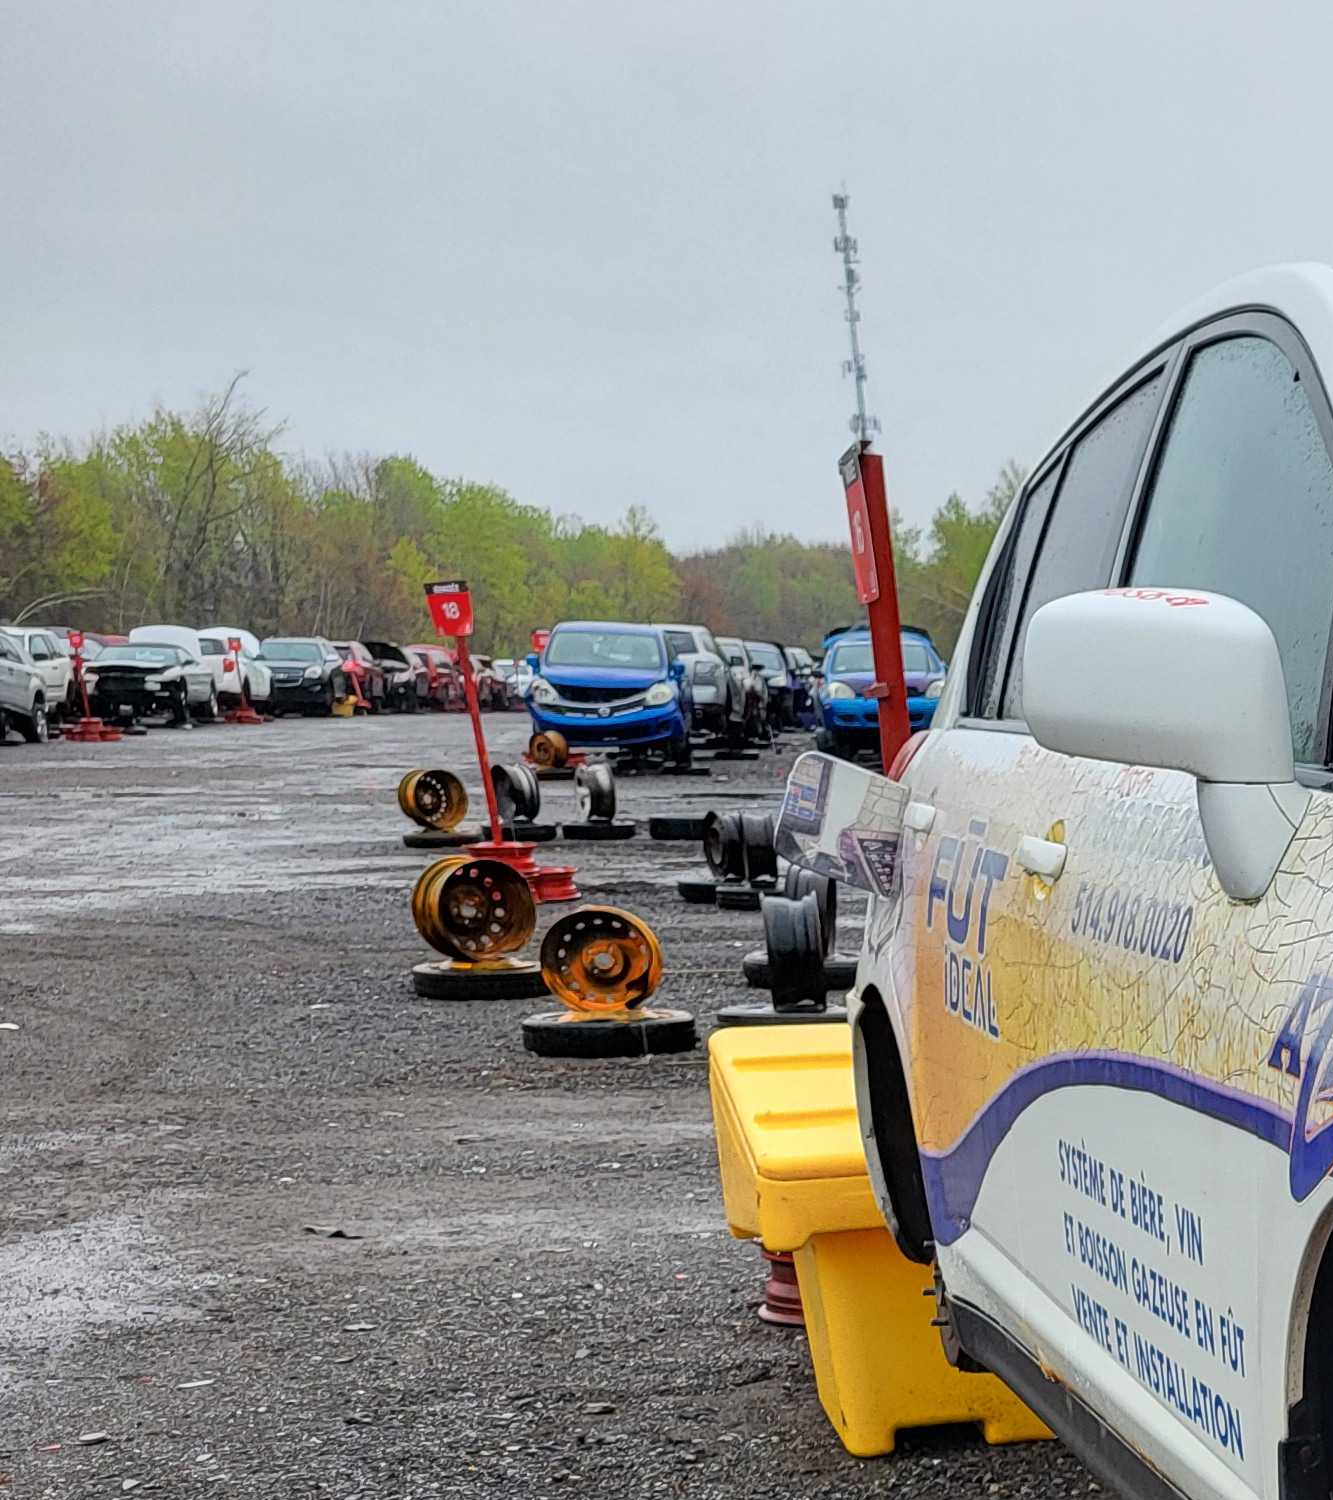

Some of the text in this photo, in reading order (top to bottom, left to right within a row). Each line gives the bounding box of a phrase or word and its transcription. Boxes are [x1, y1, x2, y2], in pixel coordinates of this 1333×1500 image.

[442, 601, 460, 619] 18
[1058, 1136, 1204, 1266] SYSTÈME DE BIÈRE, VIN
[1063, 1211, 1246, 1379] ET BOISSON GAZEUSE EN FÛT
[1071, 1283, 1245, 1462] VENTE ET INSTALLATION
